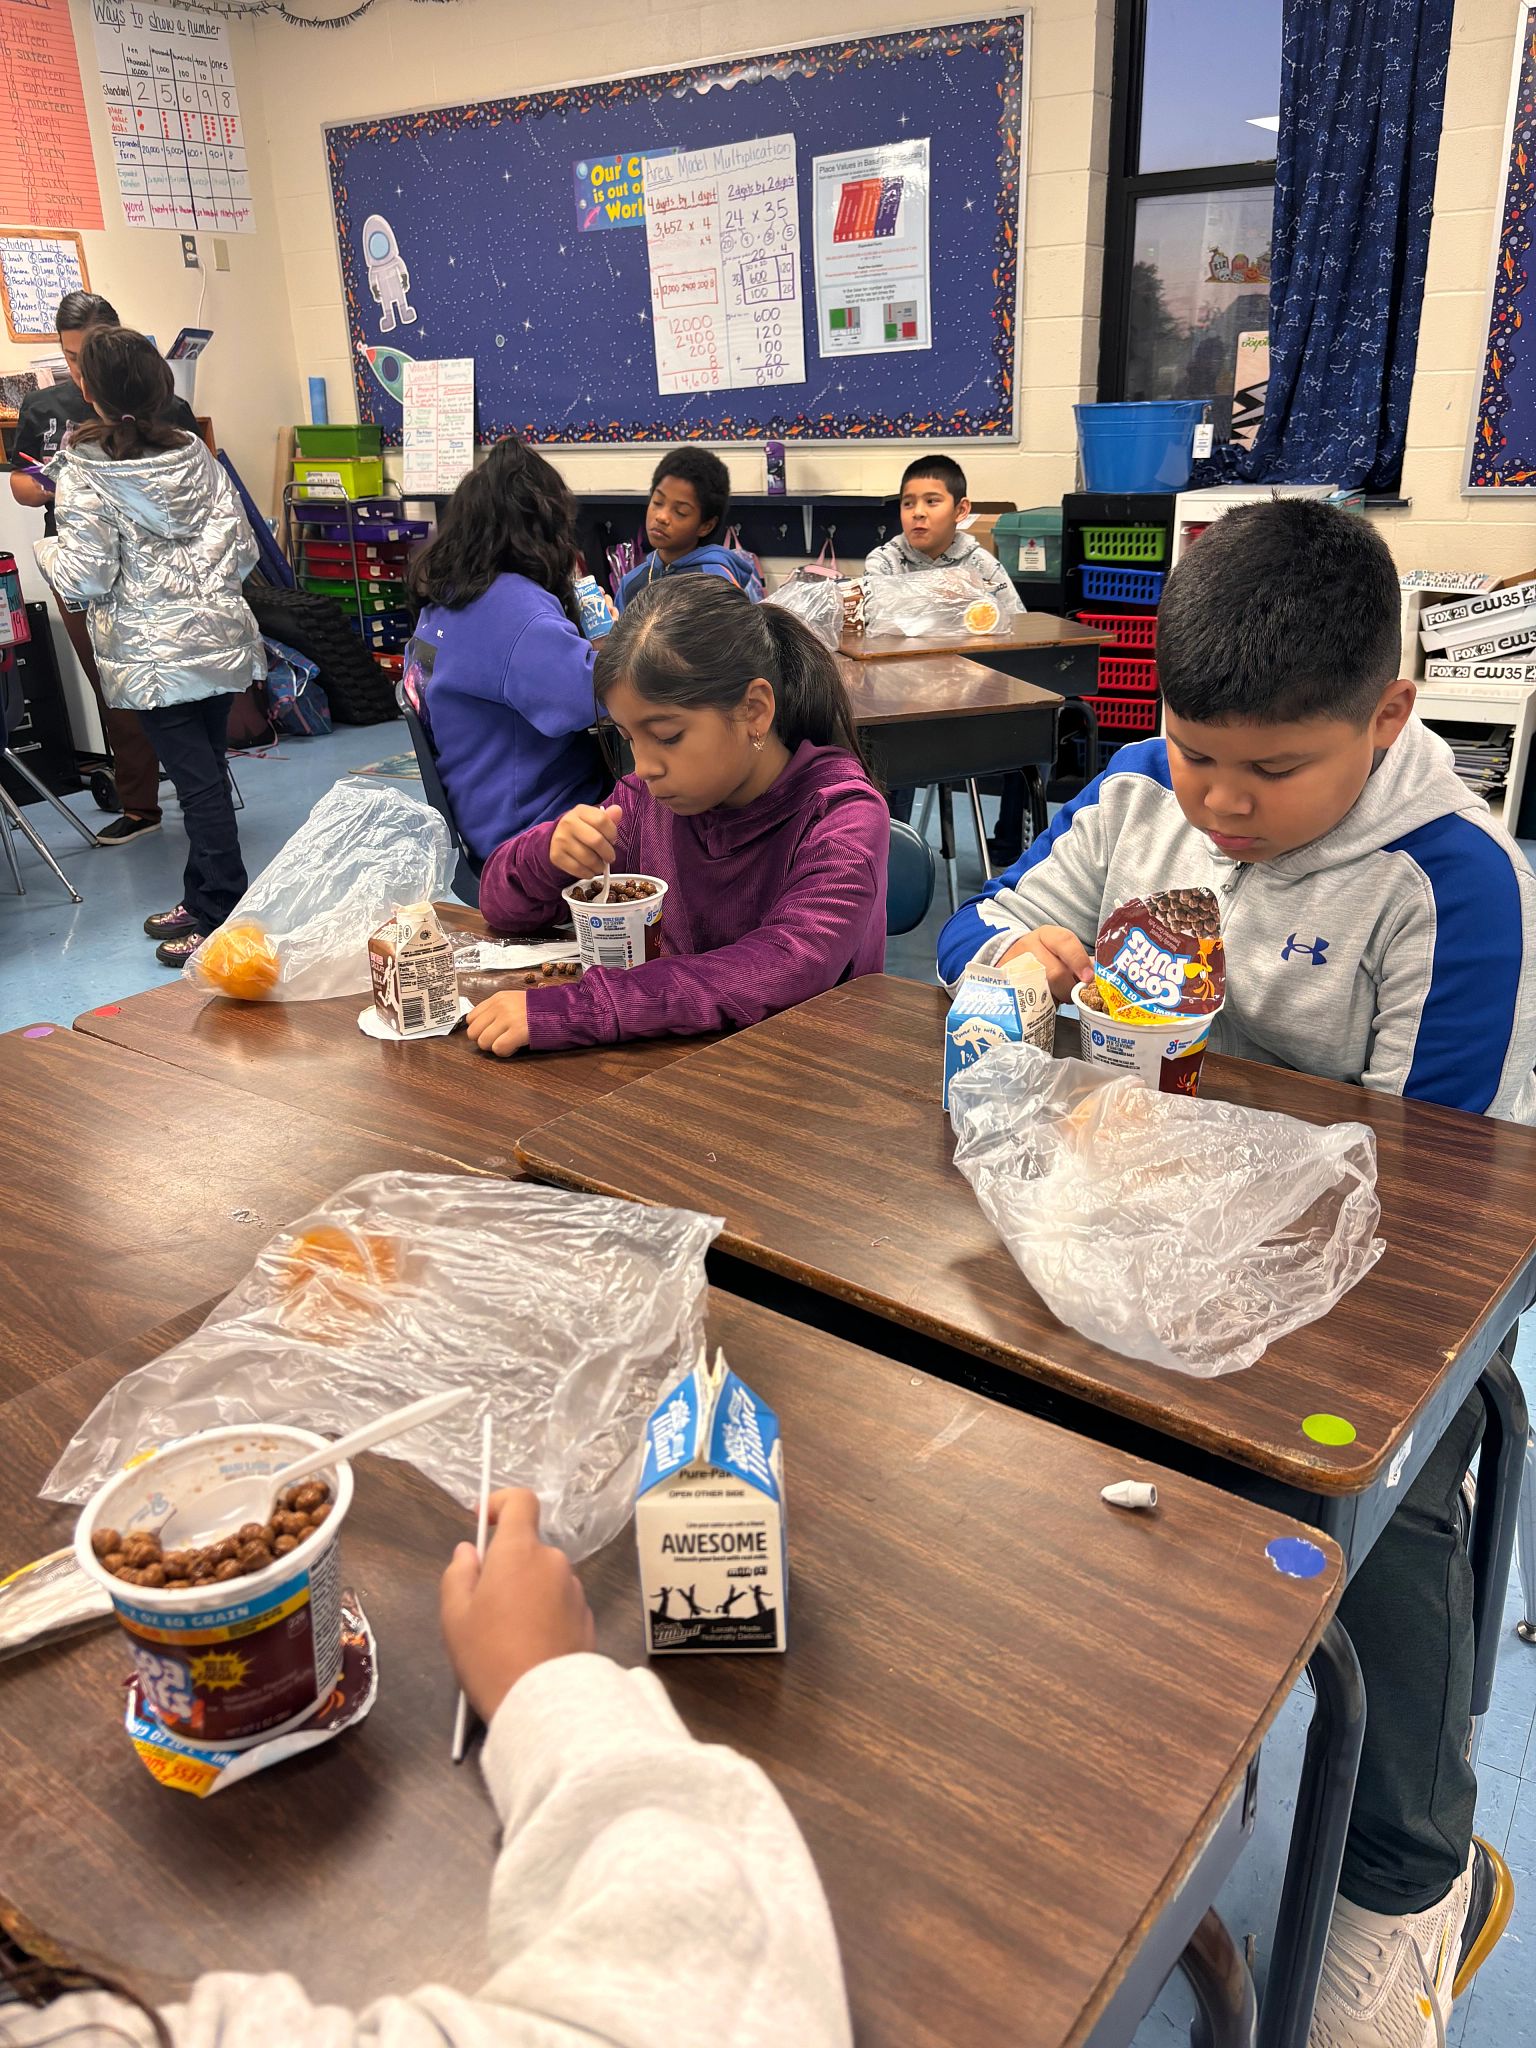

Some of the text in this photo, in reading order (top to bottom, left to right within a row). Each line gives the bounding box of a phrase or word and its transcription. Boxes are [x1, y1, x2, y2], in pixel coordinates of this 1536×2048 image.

[93, 0, 221, 35] Ways to show a number
[17, 48, 54, 64] sixteen
[211, 60, 228, 70] ones
[18, 65, 65, 80] seventeen
[23, 80, 66, 98] eighteen
[137, 82, 150, 100] 2
[182, 87, 192, 103] 6
[202, 90, 212, 107] 9
[221, 91, 231, 108] 8
[647, 142, 791, 181] Area Model Multiplication
[819, 163, 836, 175] Place
[836, 160, 857, 172] Values
[590, 157, 622, 186] Our
[593, 189, 604, 203] is
[608, 183, 628, 198] out
[728, 184, 735, 198] 2
[768, 176, 774, 190] 2
[46, 191, 83, 210] seventy
[648, 196, 654, 211] 4
[726, 208, 744, 230] 24
[765, 198, 788, 222] 35
[653, 218, 682, 238] 3,652
[703, 216, 712, 229] 4
[0, 238, 61, 254] Student List
[669, 314, 713, 335] 12000
[753, 306, 781, 323] 600
[676, 323, 782, 349] 2400 120
[690, 339, 782, 358] 200 100
[709, 354, 718, 369] 8
[765, 353, 783, 367] 20
[674, 365, 784, 390] 14,608 840
[1428, 613, 1451, 625] FOX
[1453, 606, 1467, 619] 29
[1454, 643, 1494, 661] FOX 29
[1430, 666, 1454, 677] FOX
[1456, 666, 1469, 677] 29
[1115, 948, 1181, 1008] Cocoa
[669, 1490, 693, 1498] OPEN
[694, 1489, 723, 1498] OTHER
[661, 1531, 768, 1555] AWESOME
[191, 1606, 249, 1627] GRAIN
